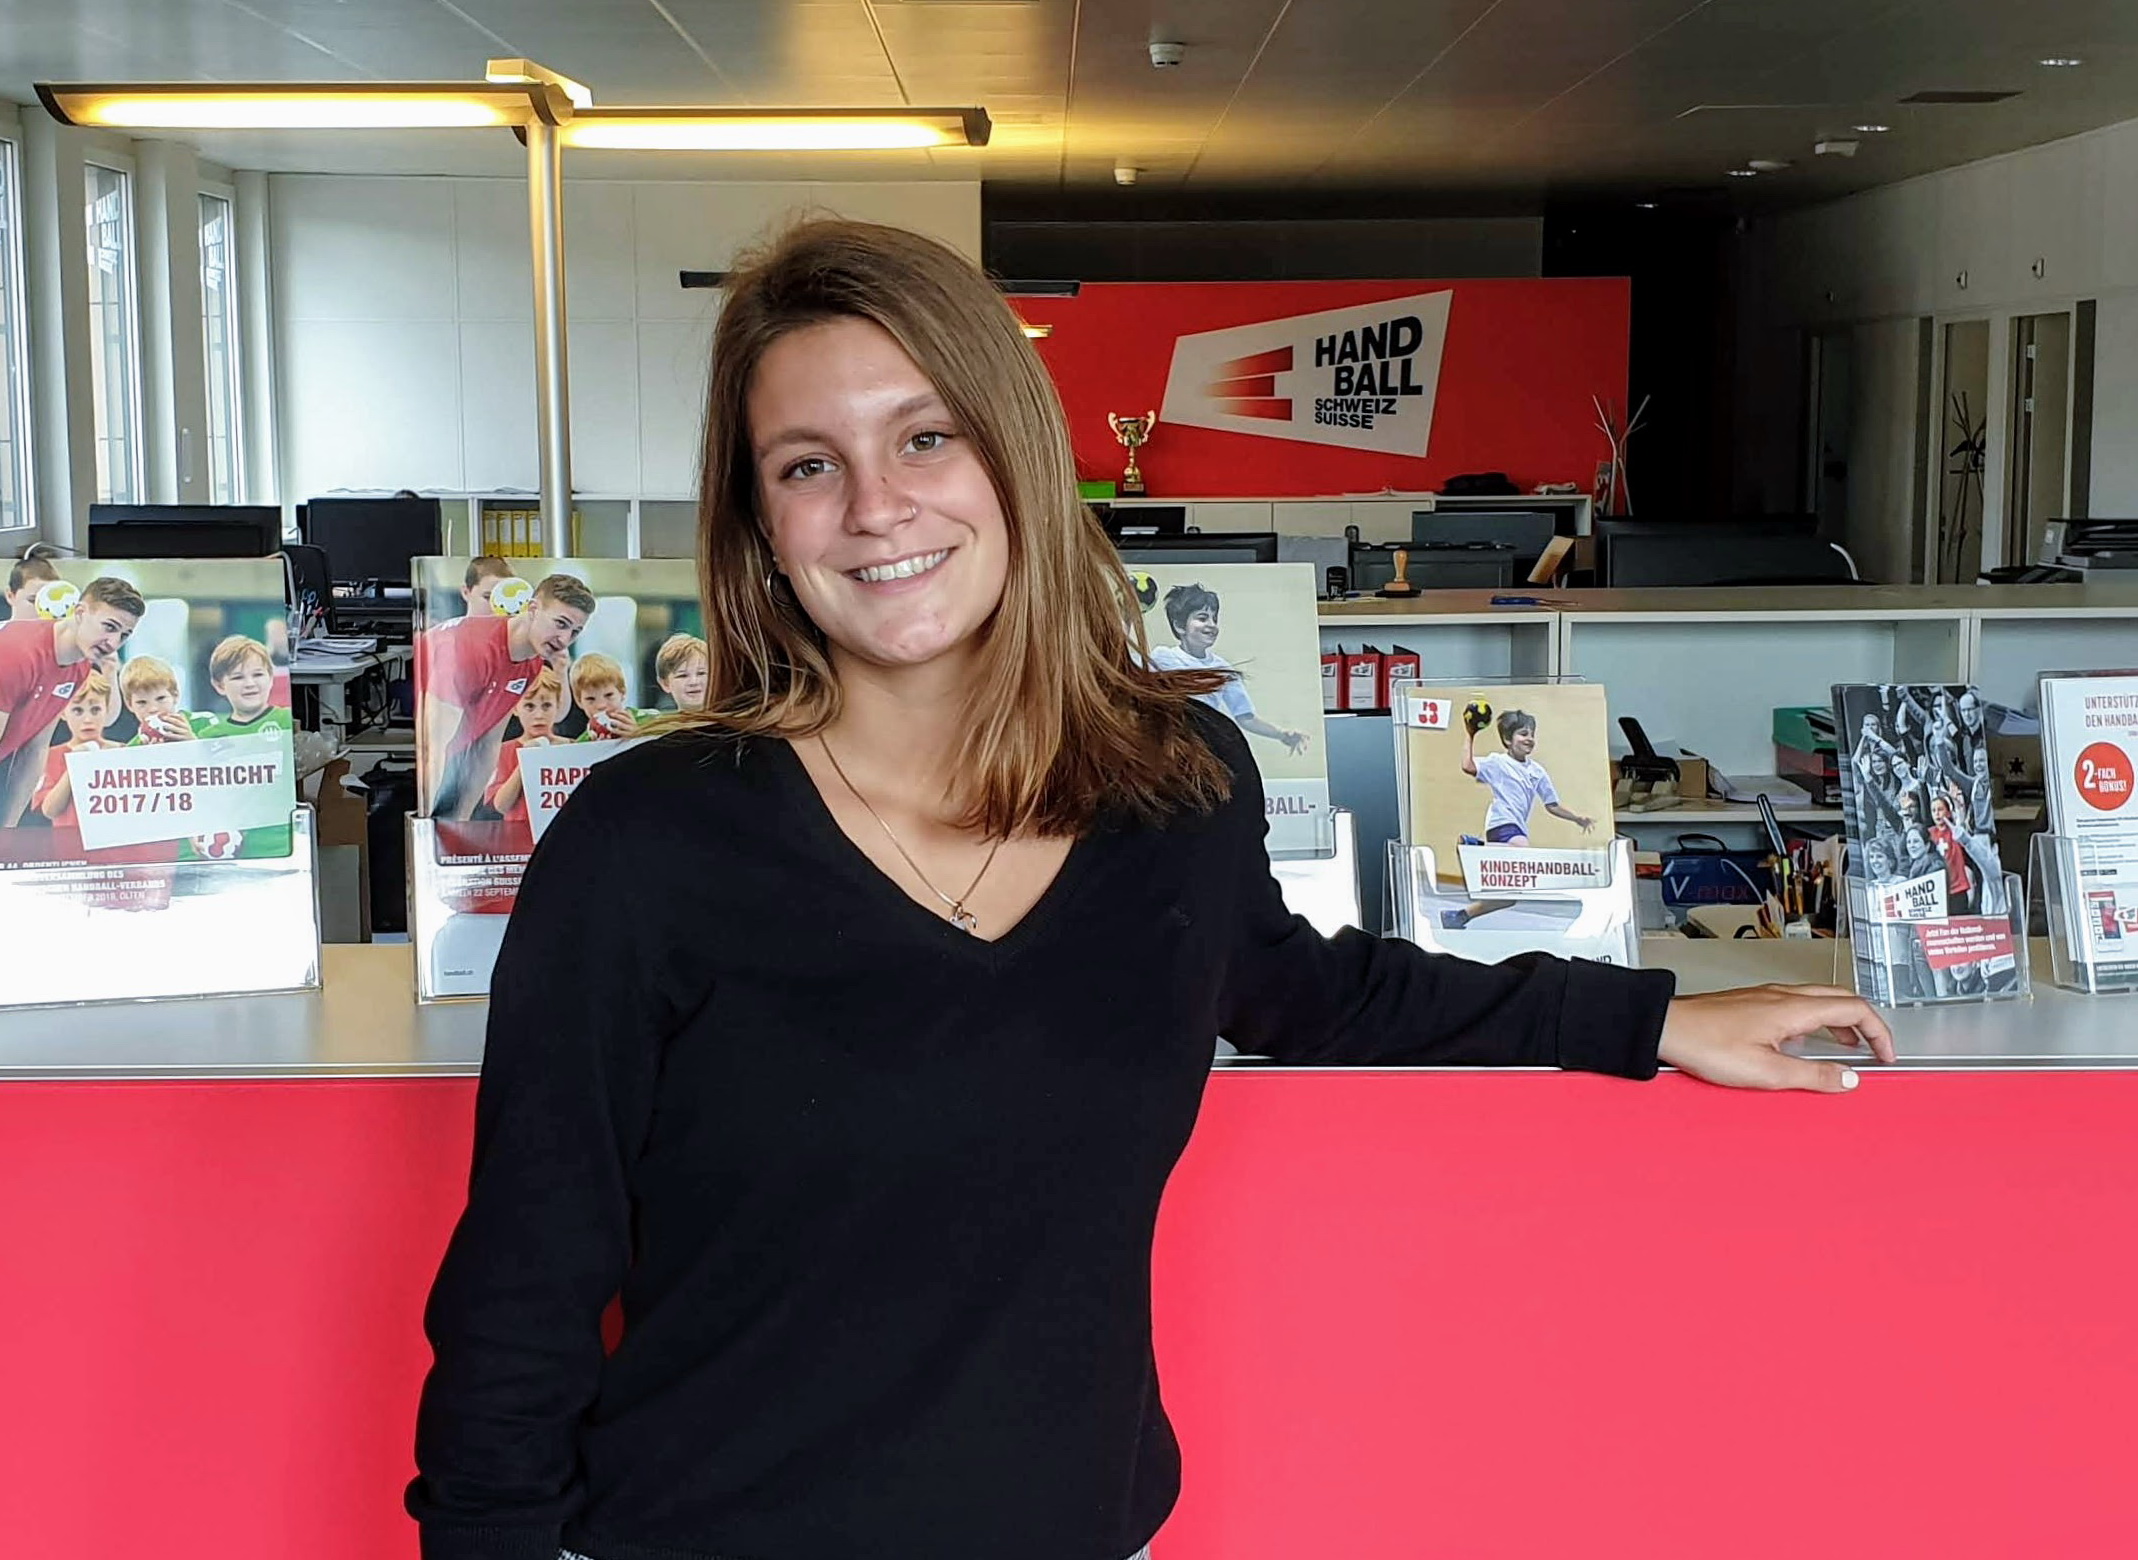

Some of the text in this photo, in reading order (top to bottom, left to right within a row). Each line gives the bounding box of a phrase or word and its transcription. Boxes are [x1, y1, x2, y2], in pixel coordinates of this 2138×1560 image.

[1315, 316, 1423, 367] HAND
[1334, 358, 1423, 396] BALL
[1315, 398, 1397, 415] SCHWEIZ
[1315, 412, 1374, 430] SUISSE
[2085, 714, 2102, 727] DEN
[88, 764, 276, 790] JAHRESBERICHT
[1480, 860, 1601, 877] KINDERHANDBALL-
[1481, 873, 1537, 888] KONZEPT
[1905, 880, 1935, 899] HAND
[1912, 893, 1939, 907] BALL
